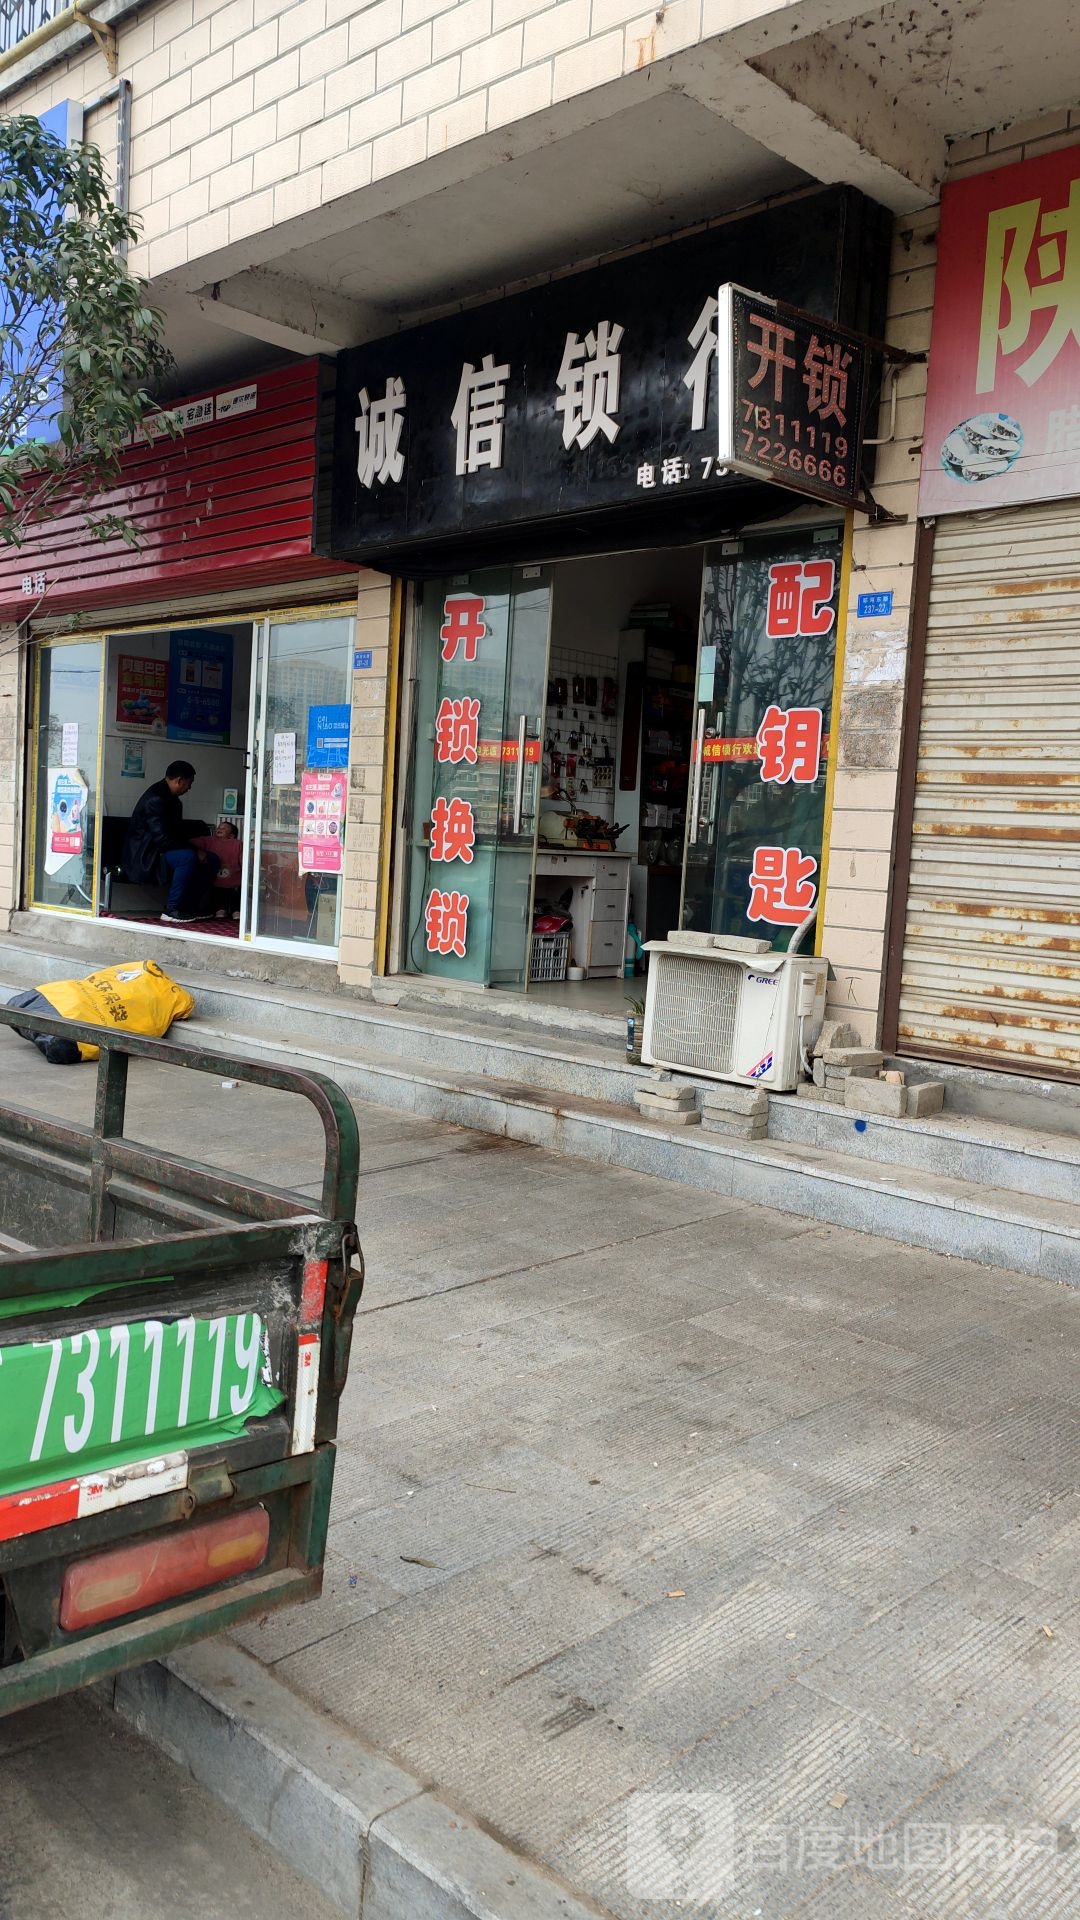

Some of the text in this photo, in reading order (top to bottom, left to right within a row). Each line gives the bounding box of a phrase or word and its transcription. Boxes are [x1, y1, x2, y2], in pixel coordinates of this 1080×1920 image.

[976, 172, 1080, 395] 陕
[746, 313, 849, 428] 开锁
[186, 402, 212, 420] 宅急送
[740, 398, 848, 459] 7311119
[740, 428, 847, 488] 7226666
[22, 571, 46, 596] 电话
[502, 746, 535, 757] 731119
[746, 559, 836, 927] 配钥匙
[424, 597, 487, 958] 开锁换锁
[755, 976, 780, 986] GREE
[29, 1312, 263, 1463] 7311119
[86, 1483, 104, 1496] 3M
